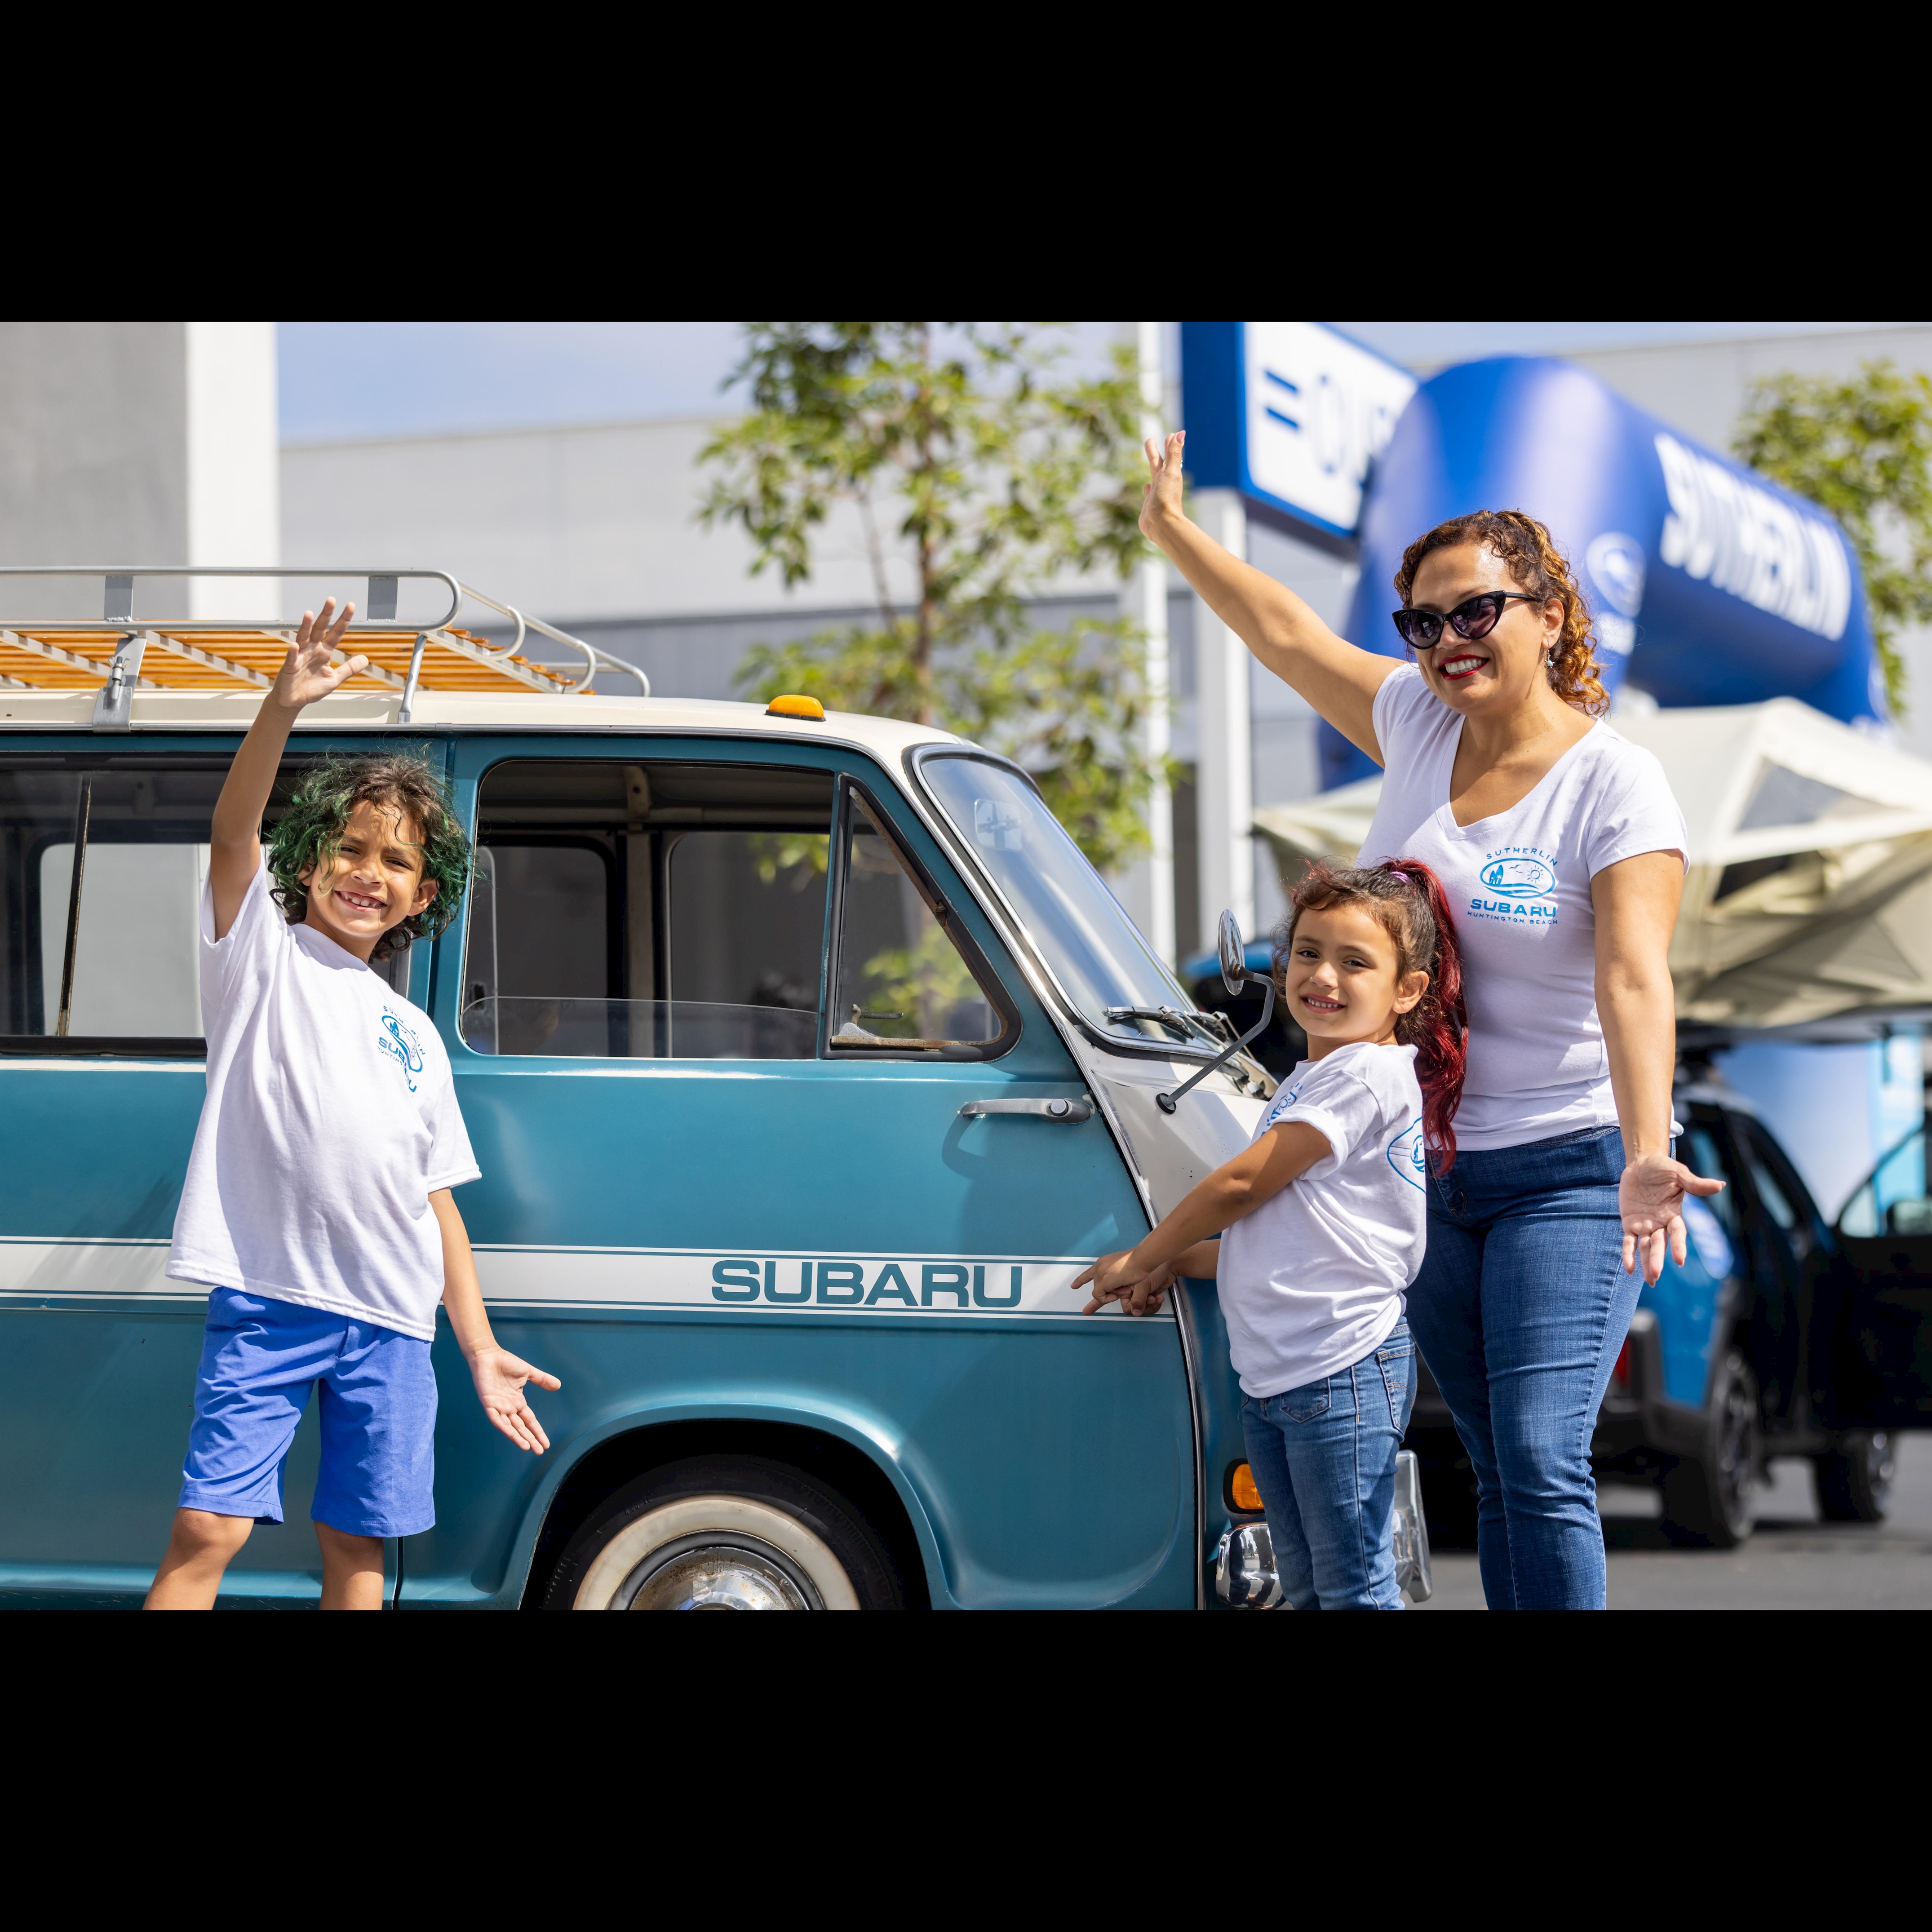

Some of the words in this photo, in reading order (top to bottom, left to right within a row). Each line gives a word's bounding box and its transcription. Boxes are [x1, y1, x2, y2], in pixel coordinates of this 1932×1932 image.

[1486, 847, 1557, 866] SUTHERLIN
[1467, 911, 1524, 923] HUNTINGTON
[1471, 899, 1556, 917] SUBARU
[711, 1260, 1022, 1308] SUBARU
